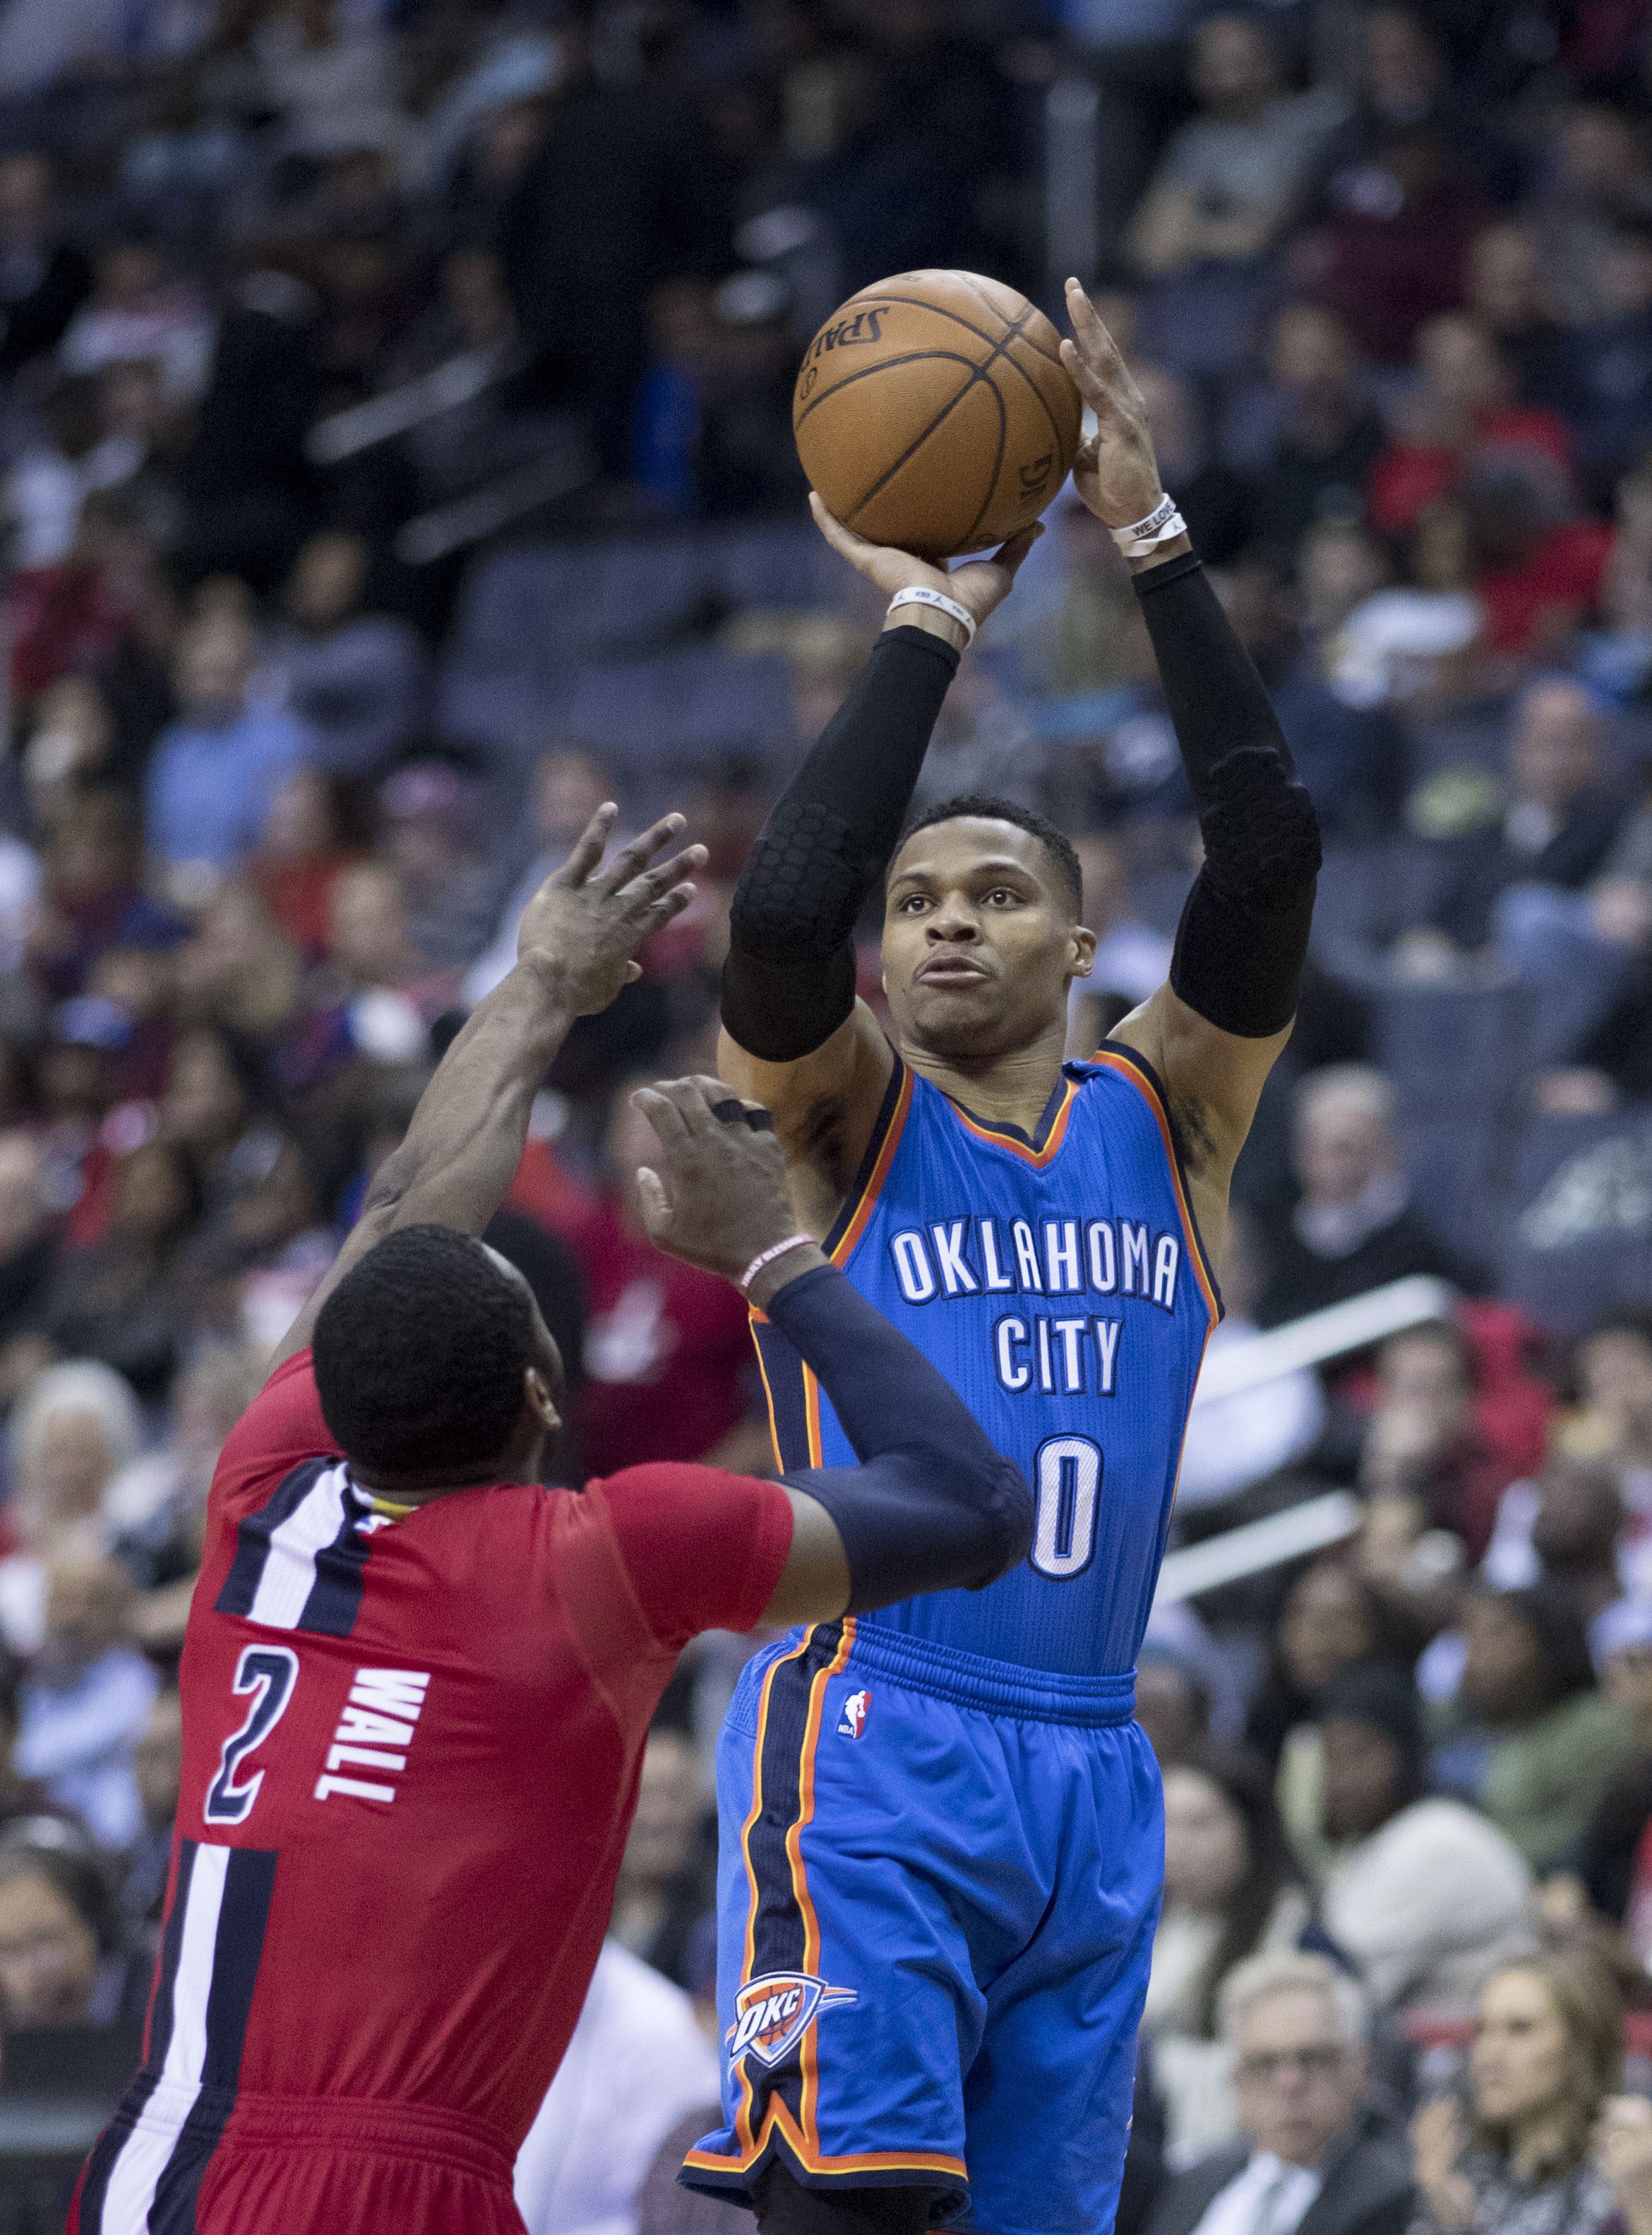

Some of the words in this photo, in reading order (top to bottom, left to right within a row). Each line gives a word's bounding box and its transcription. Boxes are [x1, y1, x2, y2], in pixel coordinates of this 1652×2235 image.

[1132, 520, 1153, 537] WE
[890, 1215, 1180, 1314] OKLAHOMA
[993, 1313, 1123, 1396] CITY
[1027, 1432, 1104, 1581] 0
[203, 1643, 299, 1825] 2
[314, 1667, 431, 1803] WALL
[837, 1724, 854, 1736] NBA
